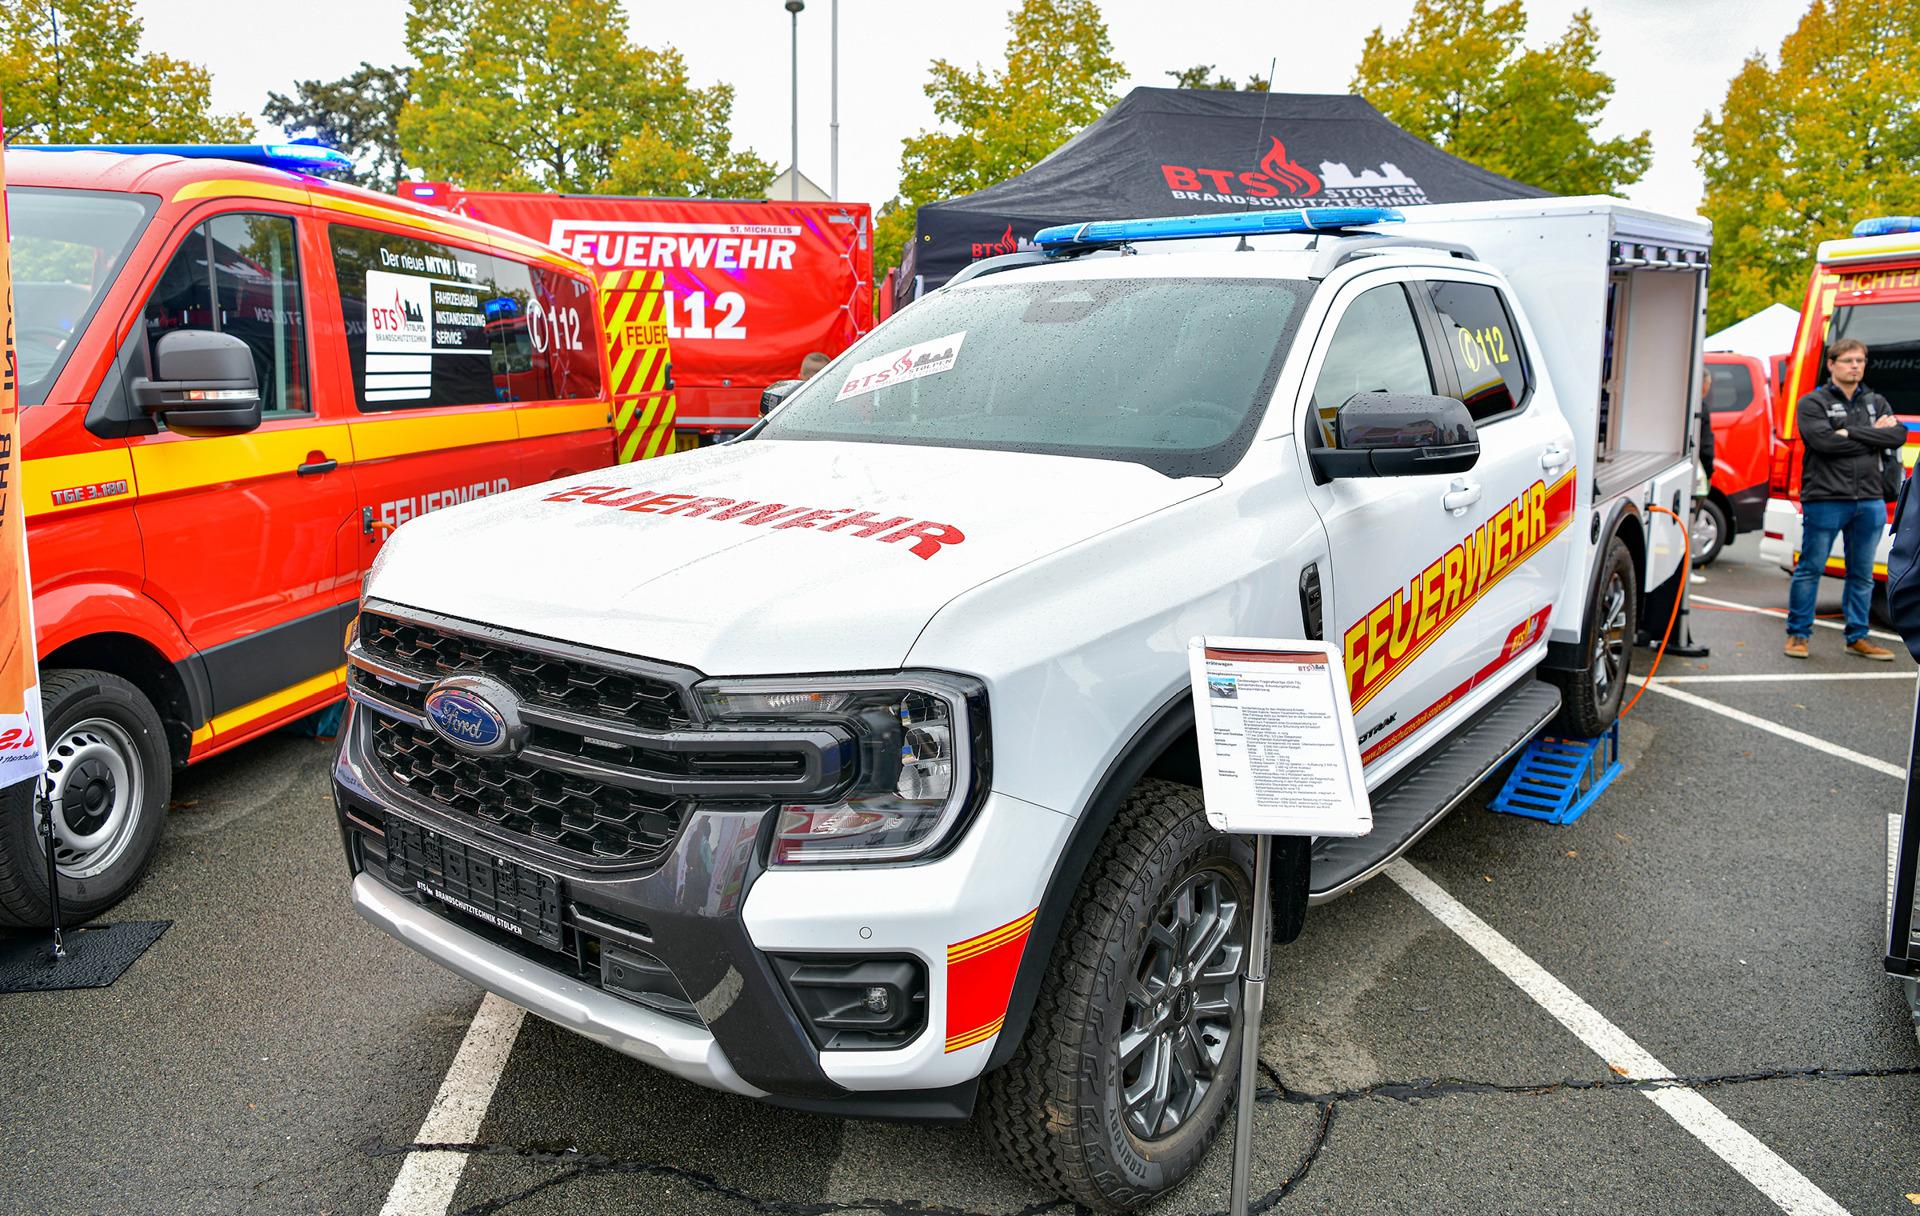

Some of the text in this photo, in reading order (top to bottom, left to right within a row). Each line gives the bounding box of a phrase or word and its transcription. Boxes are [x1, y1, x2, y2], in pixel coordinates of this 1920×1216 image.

[1161, 164, 1280, 197] BTS
[1324, 187, 1425, 199] STOLPEN
[381, 248, 400, 267] Der
[401, 255, 425, 271] neue
[425, 255, 450, 275] MTW
[971, 243, 1004, 257] BTS
[1839, 268, 1920, 292] LICHTE
[434, 290, 478, 308] FAHRZEUGBAU
[372, 307, 398, 332] BTS
[435, 310, 486, 328] INSTANDSETZUNG
[548, 305, 583, 351] 112
[435, 330, 463, 346] SERVICE
[1476, 326, 1510, 365] 112
[842, 369, 892, 394] BTS
[52, 479, 127, 505] TGE 3.180
[1345, 480, 1547, 696] FEUERWEHR
[440, 699, 483, 740] Ford
[435, 889, 496, 924] BRANDSCHUTZTECHNIK
[496, 917, 523, 936] STOLPEN
